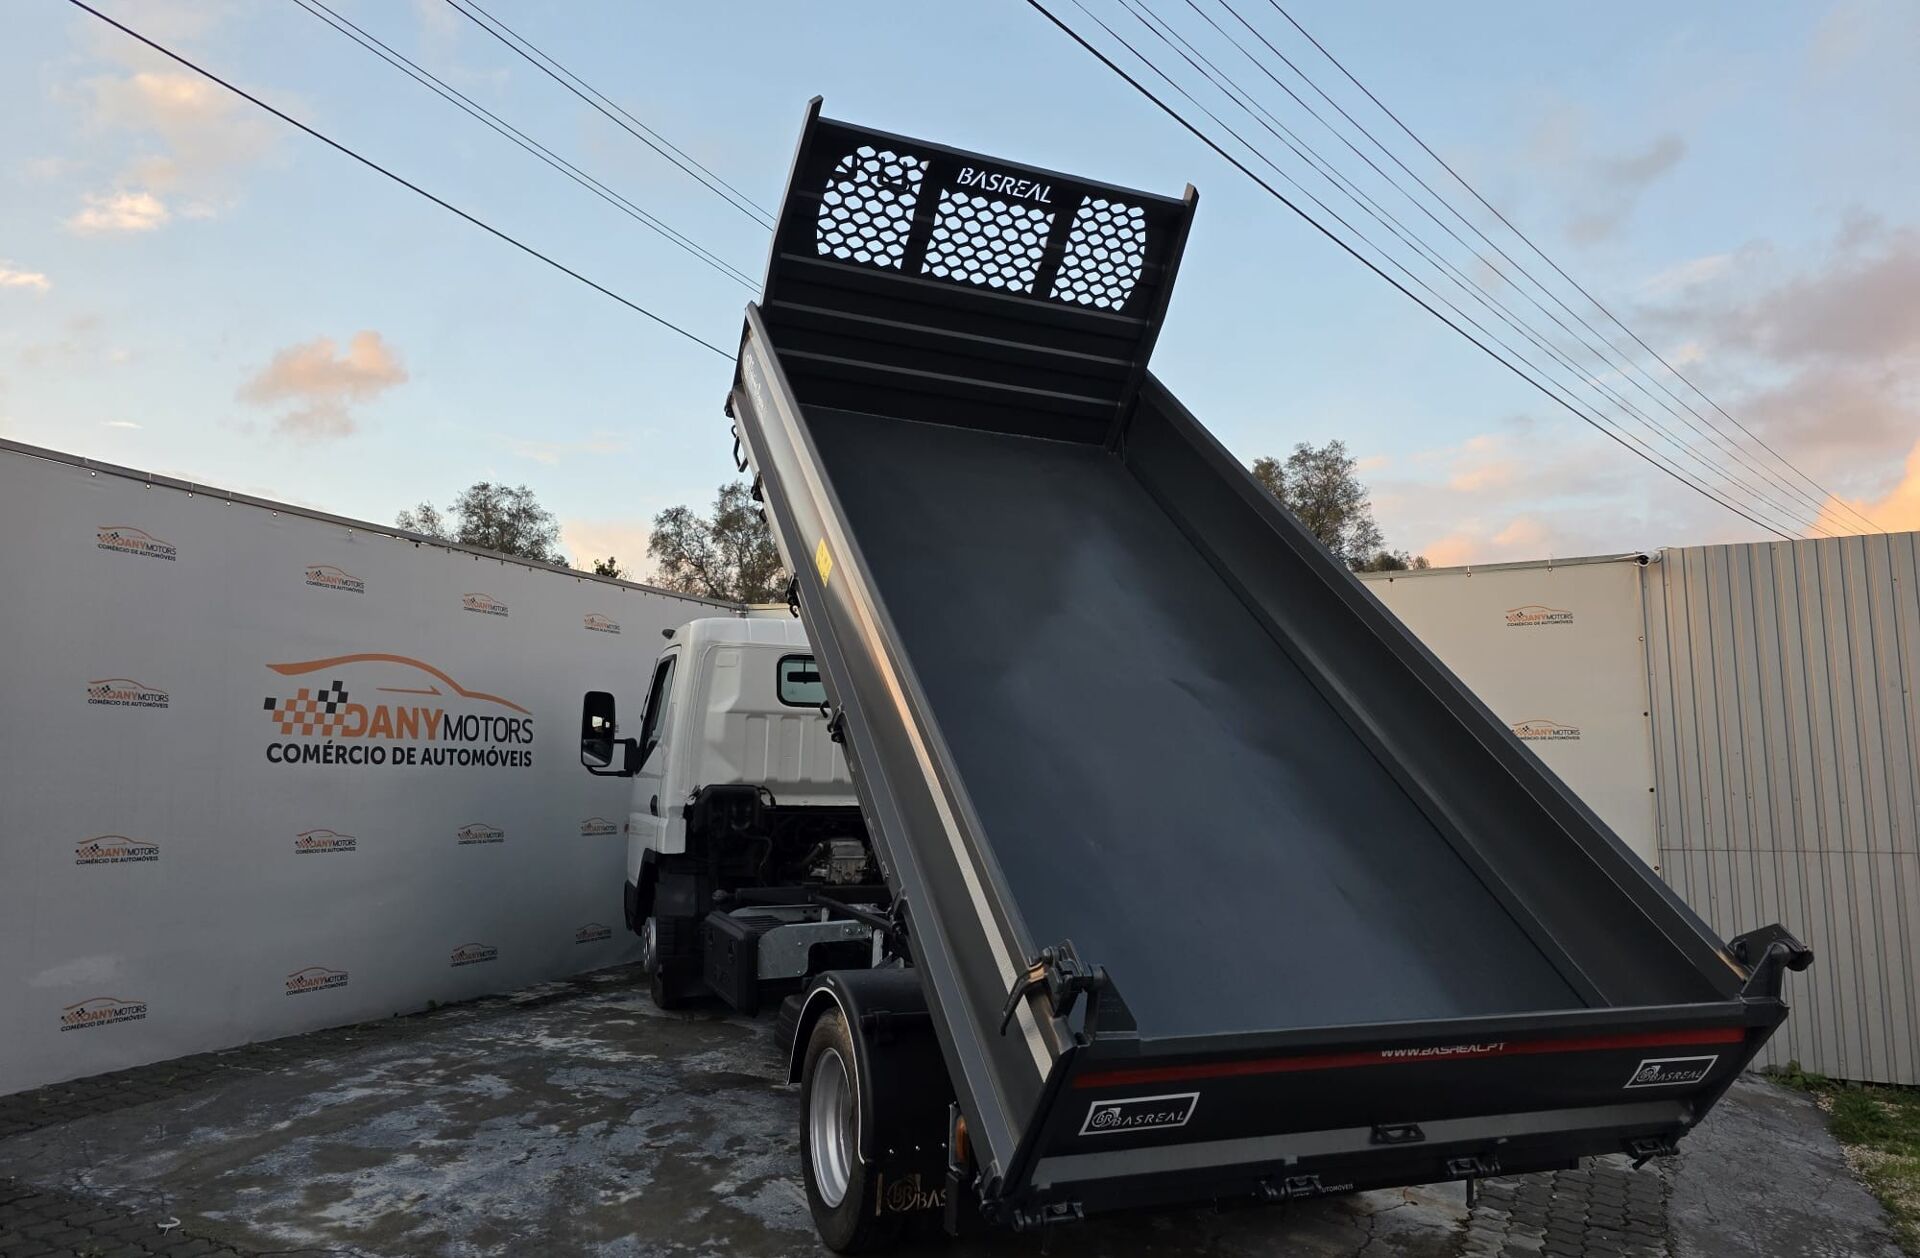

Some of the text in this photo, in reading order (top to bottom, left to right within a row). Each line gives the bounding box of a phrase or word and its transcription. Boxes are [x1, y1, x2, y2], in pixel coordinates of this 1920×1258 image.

[956, 167, 1052, 204] BASREAL
[341, 703, 535, 744] DANYMOTORS
[266, 740, 533, 768] COMÉRCIO DE AUTOMÓVEIS
[1111, 1110, 1185, 1127] BASREAL
